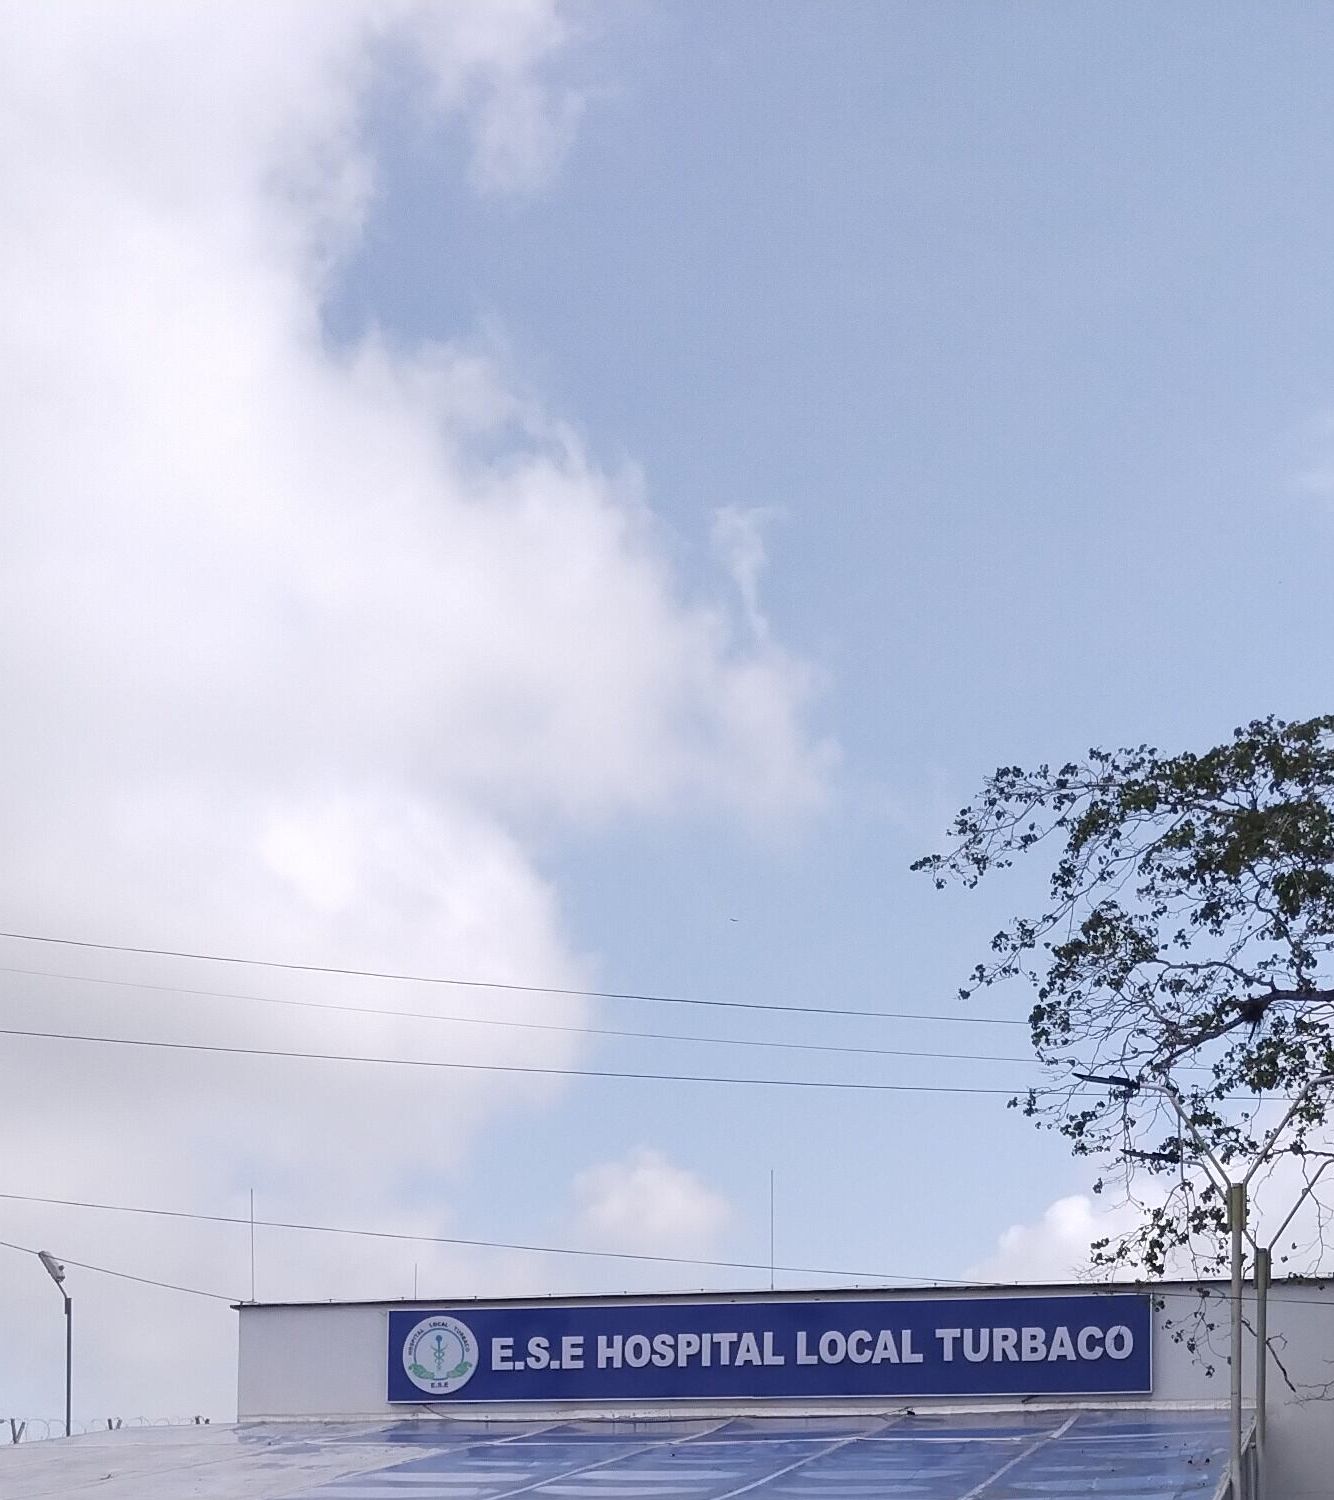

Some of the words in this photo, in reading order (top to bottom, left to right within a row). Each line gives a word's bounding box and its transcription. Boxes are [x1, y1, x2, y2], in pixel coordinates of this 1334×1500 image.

[492, 1337, 584, 1371] E.S.E
[597, 1332, 785, 1369] HOSPITAL
[796, 1329, 924, 1365] LOCAL
[935, 1325, 1134, 1363] TURBACO
